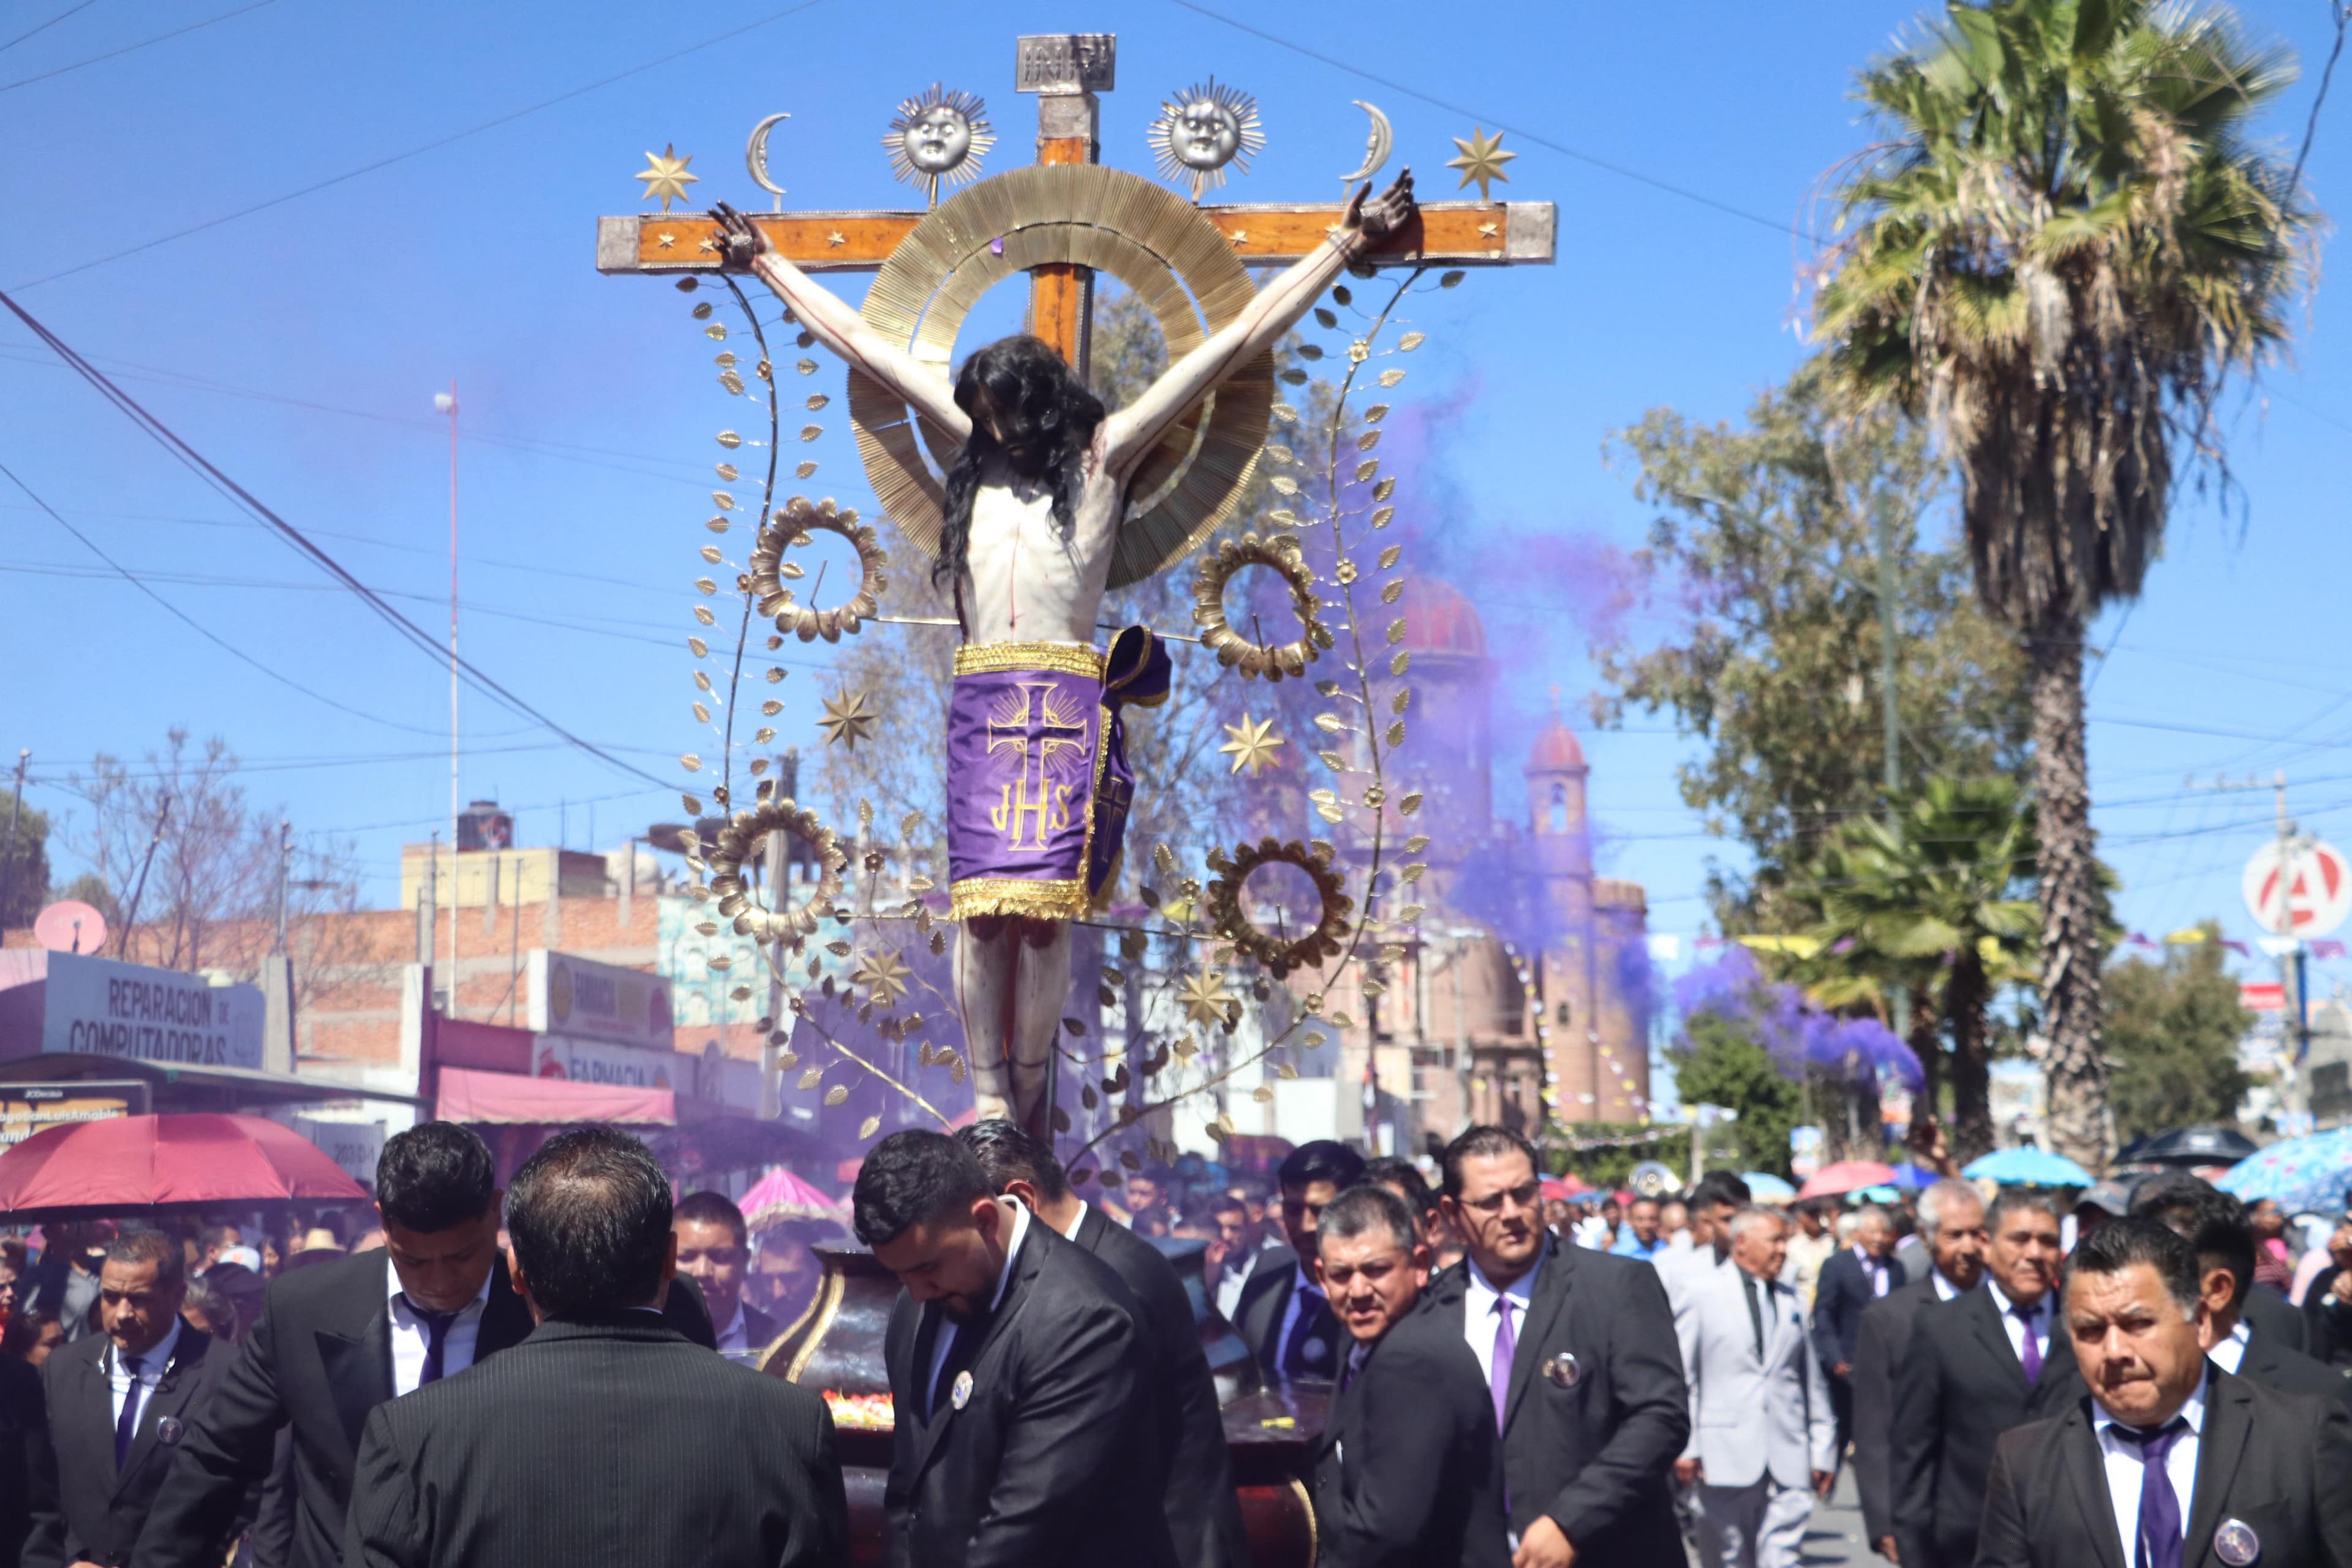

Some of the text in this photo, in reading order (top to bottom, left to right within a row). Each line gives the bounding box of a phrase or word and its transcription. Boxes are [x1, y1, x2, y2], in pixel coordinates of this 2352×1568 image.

[108, 978, 211, 1027] REPARACION
[70, 1019, 227, 1065] COMPUTADORAS
[570, 1058, 644, 1088] FARMACIA
